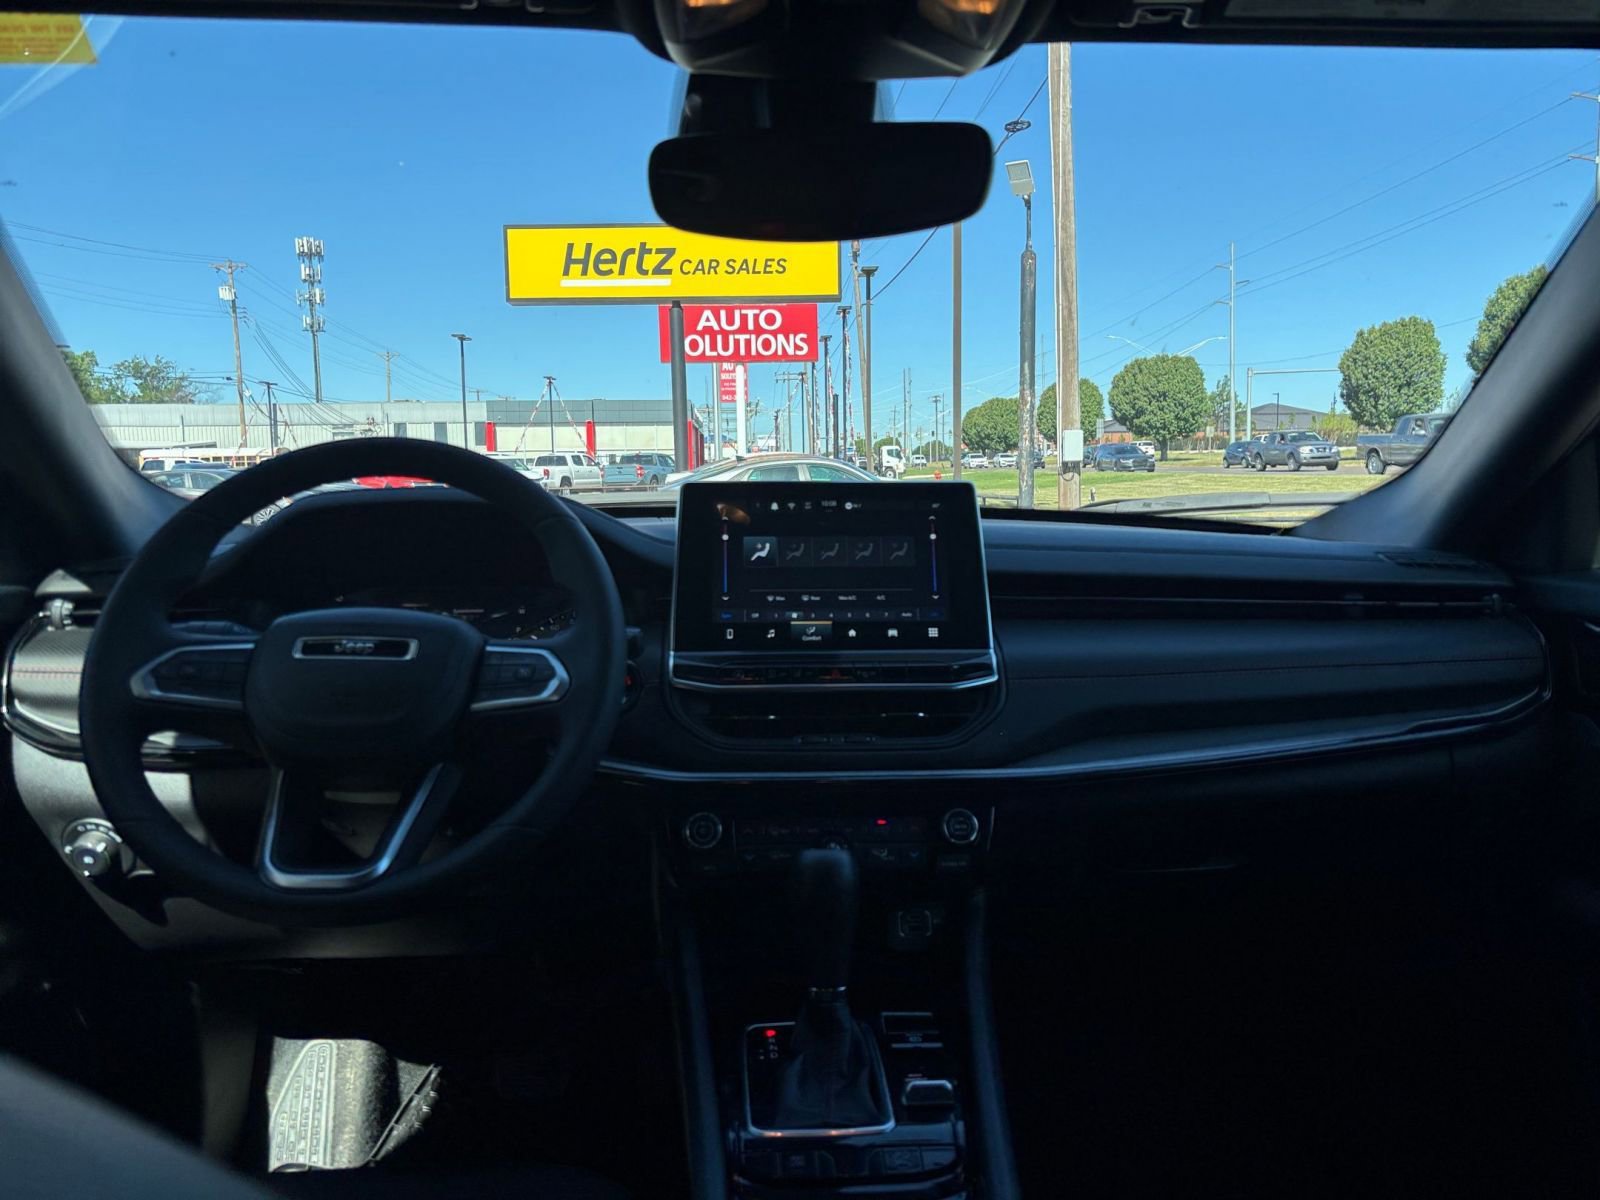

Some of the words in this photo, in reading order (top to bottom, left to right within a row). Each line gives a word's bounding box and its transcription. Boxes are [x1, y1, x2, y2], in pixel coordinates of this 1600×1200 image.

[562, 242, 676, 277] Hertz
[679, 259, 720, 275] CAR
[724, 258, 787, 275] SALES
[696, 309, 782, 331] AUTO
[683, 333, 809, 357] OLUTIONS
[334, 640, 375, 654] Jeep
